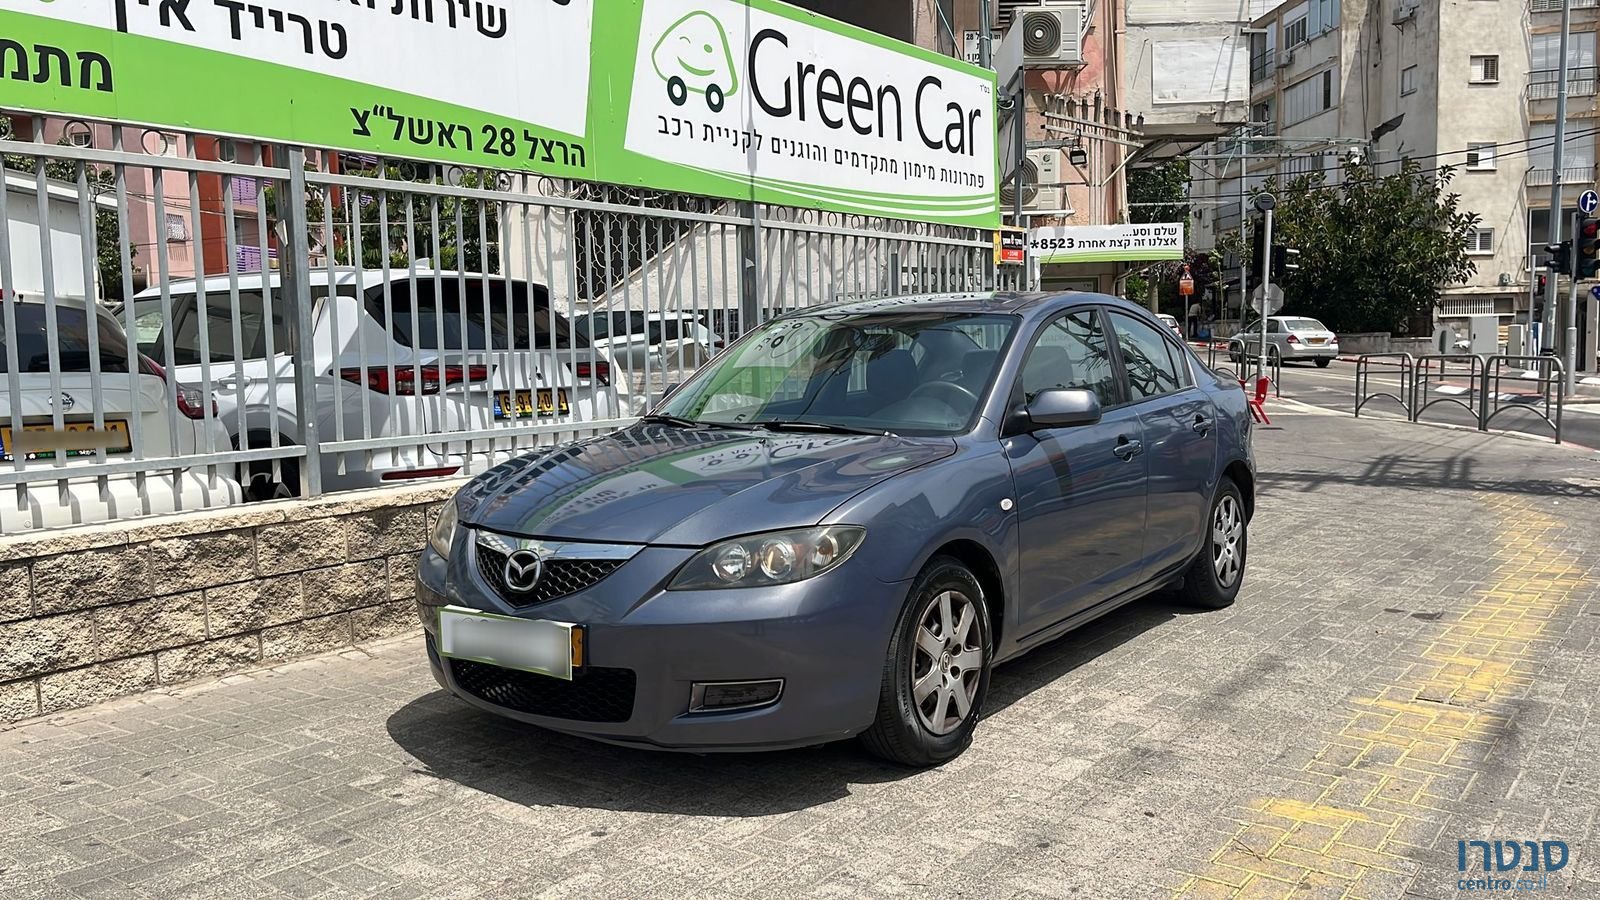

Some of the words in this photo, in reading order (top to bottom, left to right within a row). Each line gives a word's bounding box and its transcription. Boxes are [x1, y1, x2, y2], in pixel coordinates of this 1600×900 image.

[214, 0, 348, 60] טרייד
[748, 28, 902, 142] Green
[915, 75, 981, 157] Car
[657, 115, 693, 139] רכב
[702, 123, 763, 154] לקניית
[481, 124, 516, 157] 28
[521, 129, 585, 168] הרצל
[771, 136, 827, 162] והוגנים
[834, 148, 898, 175] מתקדמים
[903, 161, 935, 180] מימון
[940, 168, 984, 188] פתרונות
[1078, 239, 1106, 248] אחרת
[1134, 237, 1145, 246] זה
[1148, 237, 1177, 246] אצלנו
[1154, 227, 1177, 236] שלם
[1109, 239, 1131, 249] קצת
